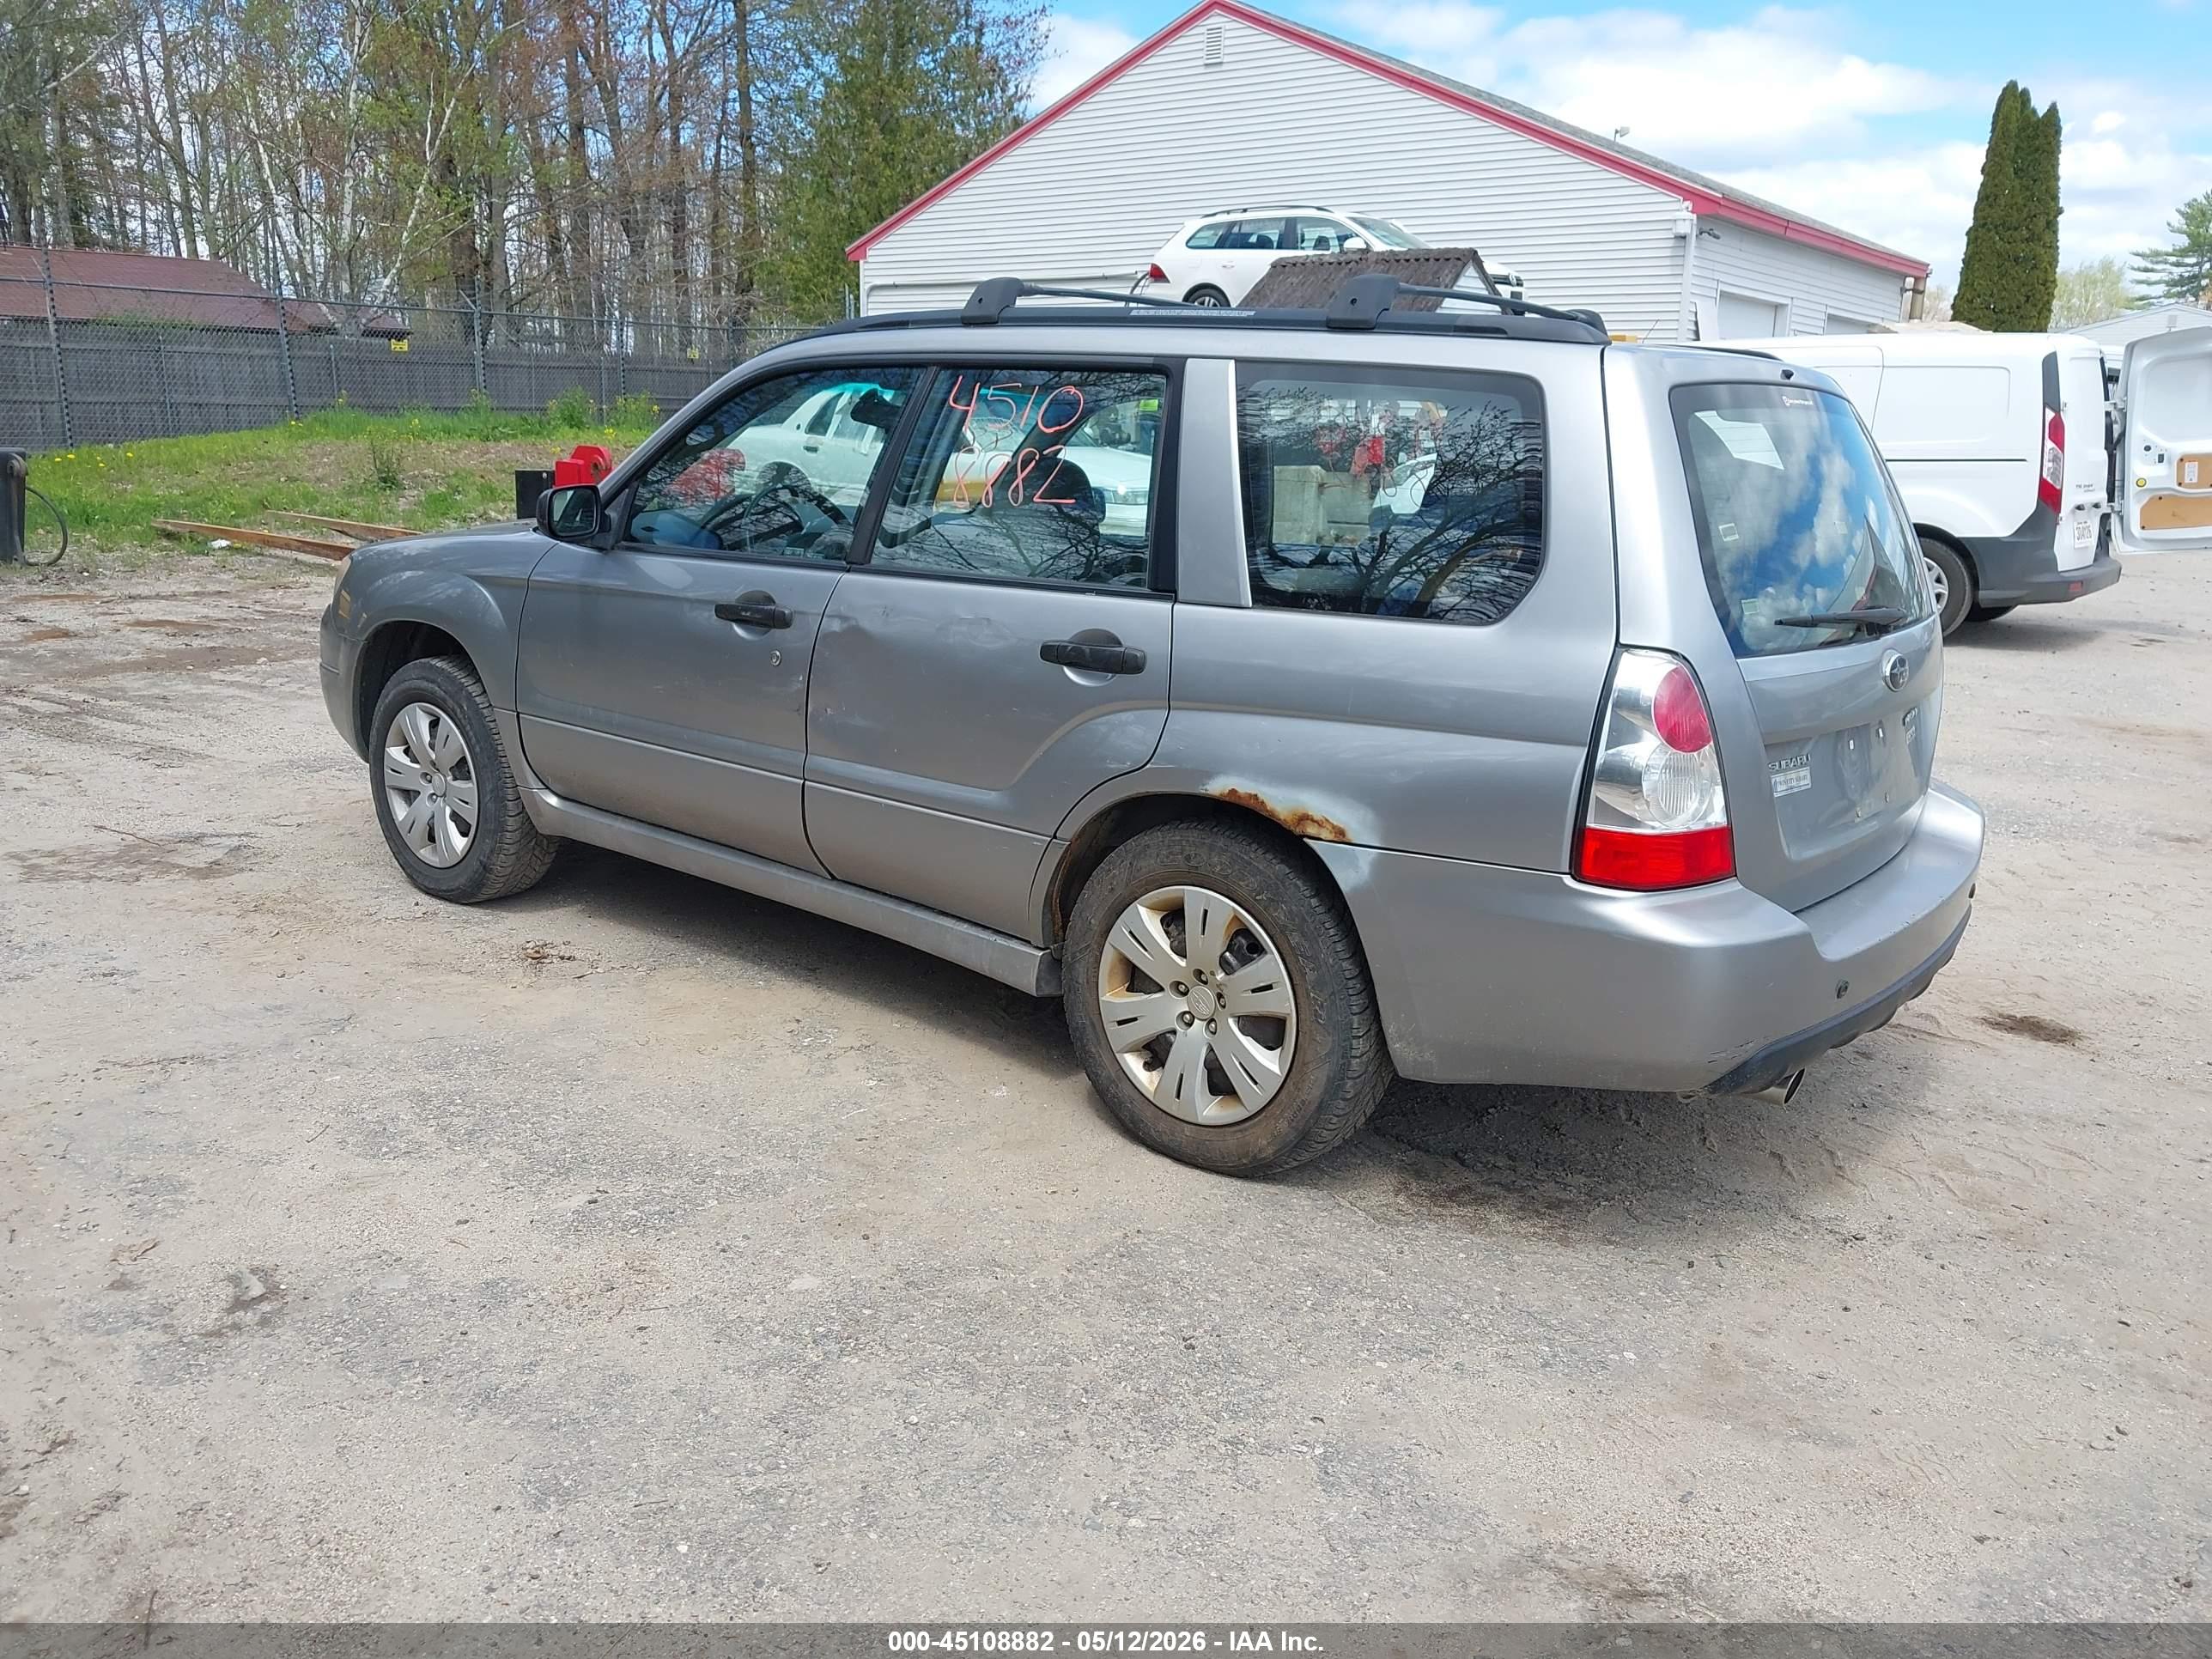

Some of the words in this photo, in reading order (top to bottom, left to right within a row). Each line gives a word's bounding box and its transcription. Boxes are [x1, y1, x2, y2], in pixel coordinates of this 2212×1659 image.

[948, 374, 1085, 434] 4510
[952, 444, 1076, 508] 8882
[1767, 752, 1812, 771] SUBARU
